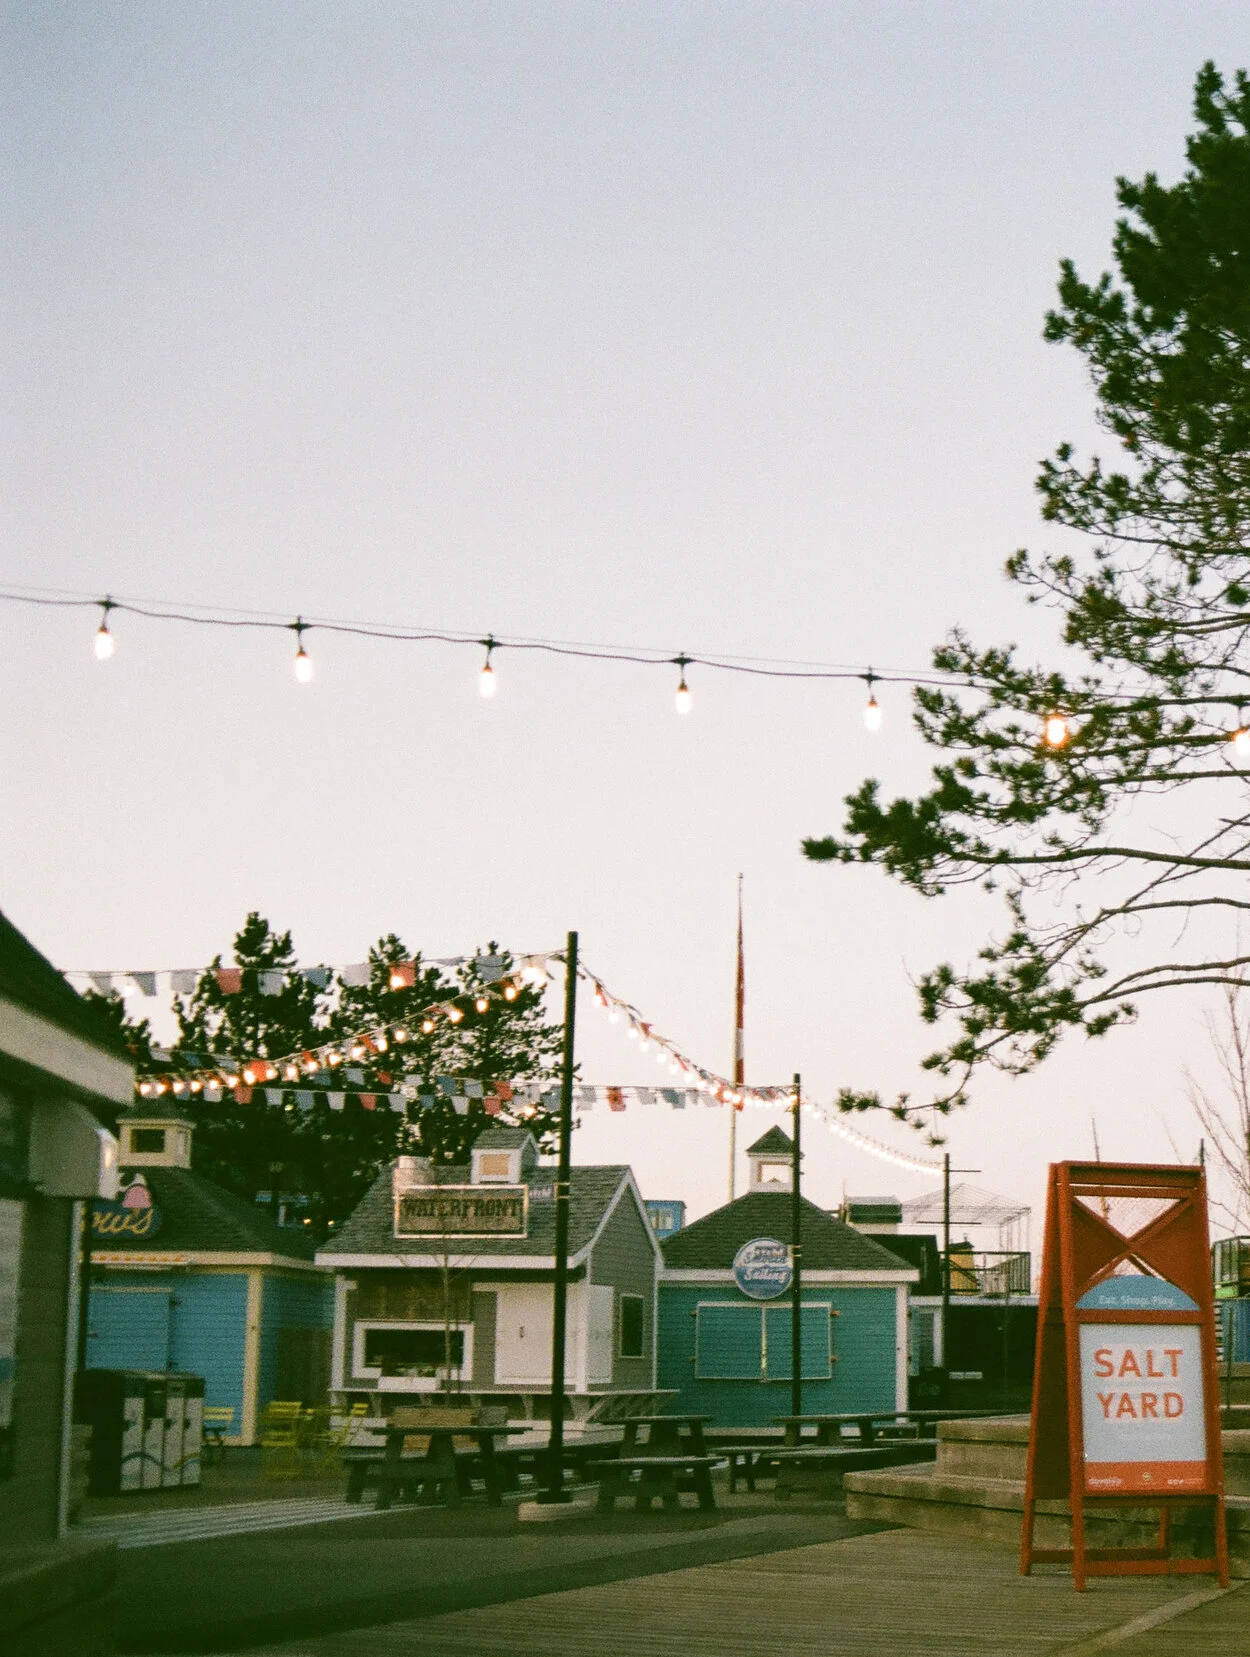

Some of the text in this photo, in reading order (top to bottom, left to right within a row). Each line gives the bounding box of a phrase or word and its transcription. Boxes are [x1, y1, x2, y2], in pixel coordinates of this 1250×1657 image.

[401, 1198, 521, 1218] WATERFRONT
[1093, 1348, 1184, 1378] SALT
[1096, 1391, 1185, 1419] YARD
